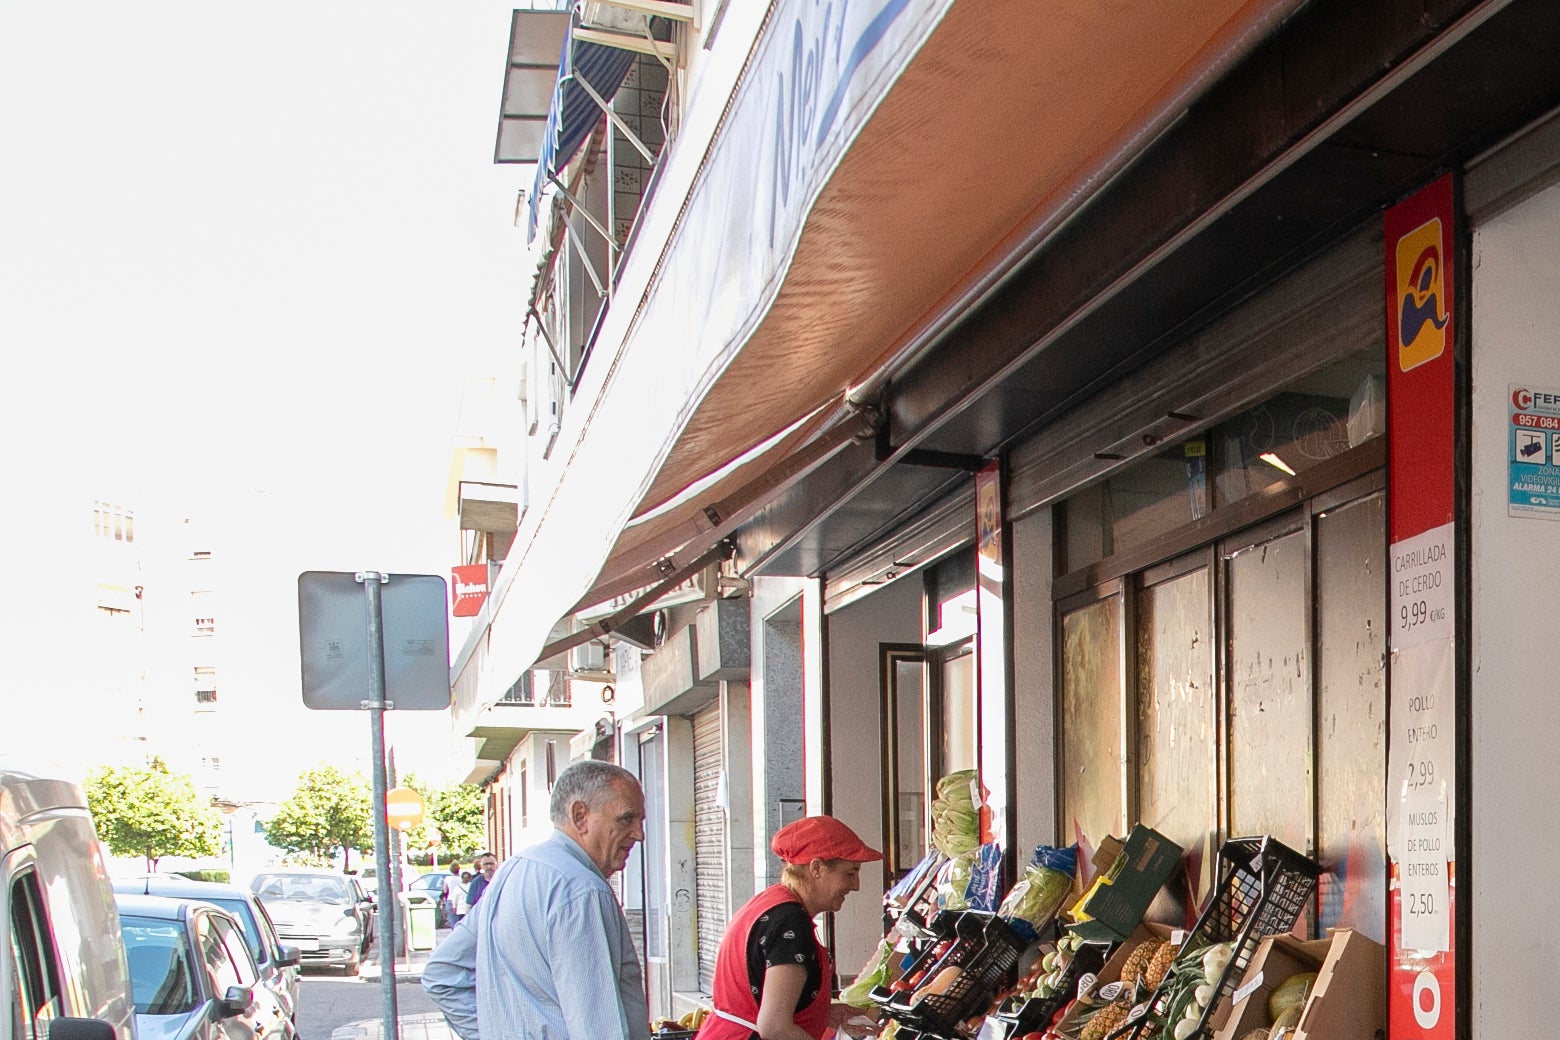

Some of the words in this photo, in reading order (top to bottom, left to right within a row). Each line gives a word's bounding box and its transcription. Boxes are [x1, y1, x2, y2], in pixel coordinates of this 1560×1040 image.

[1519, 415, 1538, 427] 957
[1540, 418, 1559, 429] 084
[1538, 466, 1560, 476] ZONA
[1513, 482, 1546, 493] ALARMA
[1547, 485, 1557, 494] 24
[1395, 543, 1446, 573] CARRILLADA
[1399, 580, 1410, 597] DE
[1411, 570, 1442, 594] CERDO
[1401, 600, 1427, 632] 9,99
[1430, 607, 1445, 622] €/KG
[1409, 694, 1435, 714] POLLO
[1407, 724, 1438, 744] ENTERO
[1408, 761, 1435, 789] 2,99
[1408, 811, 1438, 827] MUSLOS
[1408, 839, 1417, 852] DE
[1418, 837, 1441, 851] POLLO
[1408, 862, 1439, 876] ENTEROS
[1409, 893, 1435, 921] 2,50
